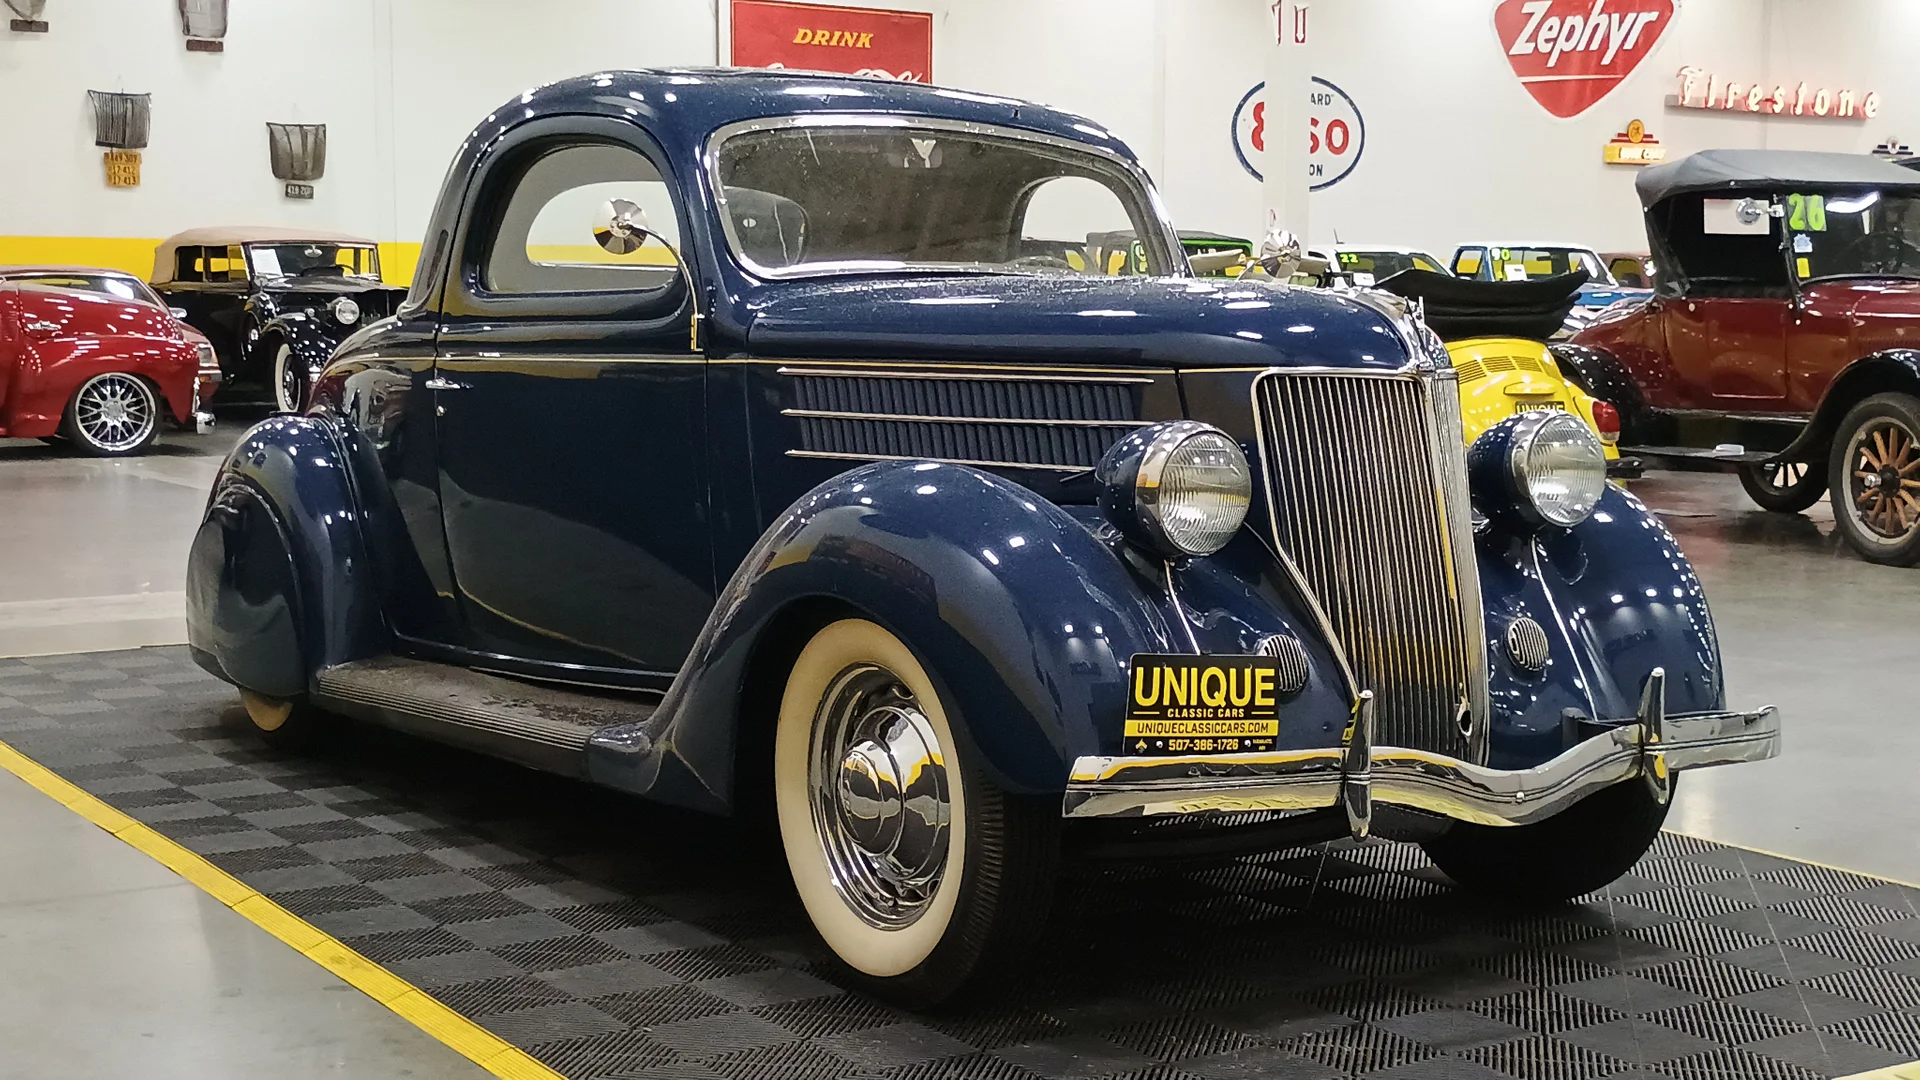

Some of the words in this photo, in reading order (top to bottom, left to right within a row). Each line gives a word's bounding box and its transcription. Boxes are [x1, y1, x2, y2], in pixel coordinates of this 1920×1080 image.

[792, 27, 874, 49] DRINK
[1508, 0, 1660, 68] Zephyr
[1676, 65, 1881, 119] Firestone
[1788, 192, 1826, 231] 26
[1339, 253, 1359, 263] 22
[1135, 666, 1276, 708] UNIQUE
[1167, 708, 1214, 718] CLASSIC
[1217, 708, 1245, 718] CARS
[1137, 722, 1269, 735] UNIQUECLASSICCARS.COM
[1168, 738, 1239, 751] 507-386-1726
